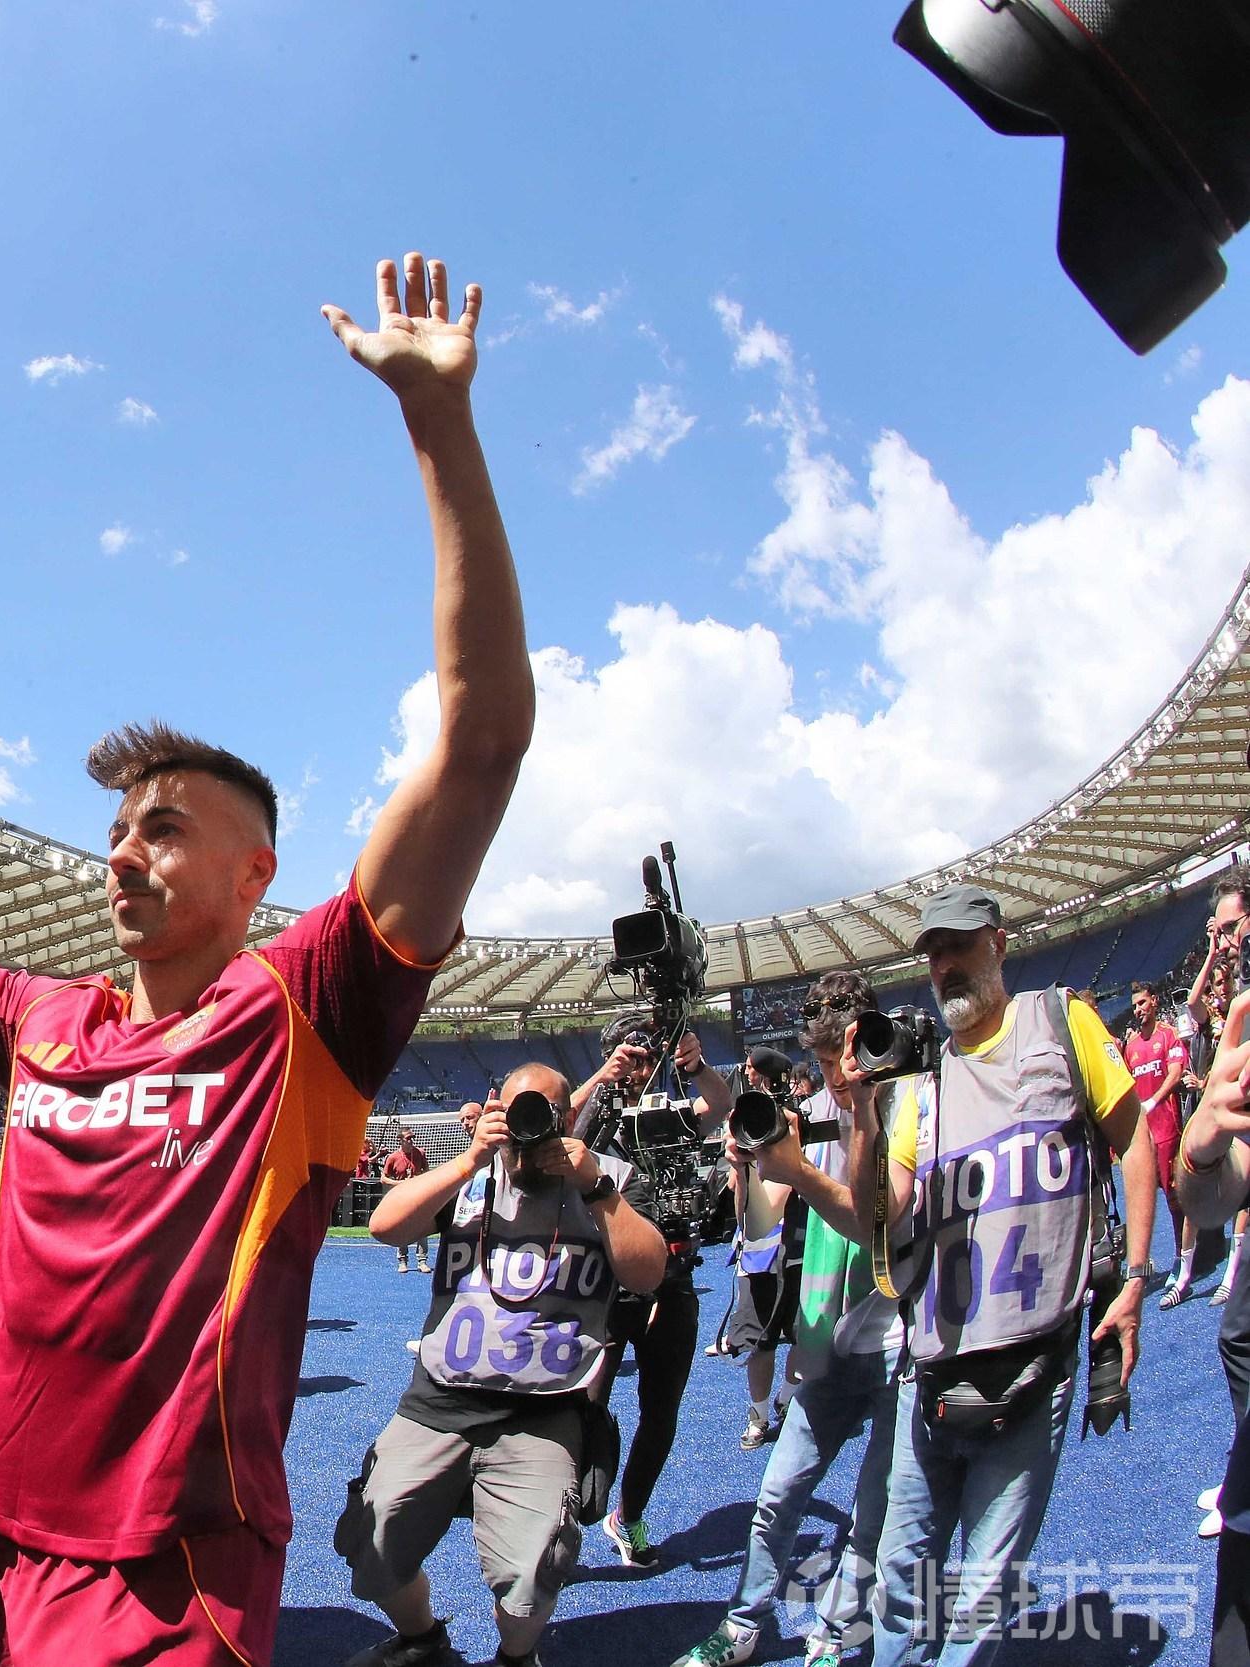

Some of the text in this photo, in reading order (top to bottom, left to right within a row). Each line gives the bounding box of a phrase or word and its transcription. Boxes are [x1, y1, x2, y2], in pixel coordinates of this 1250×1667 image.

[762, 1030, 793, 1040] OLIMPICO
[10, 1072, 226, 1131] EROBET
[445, 1242, 603, 1296] PHOTO
[444, 1305, 583, 1374] 038
